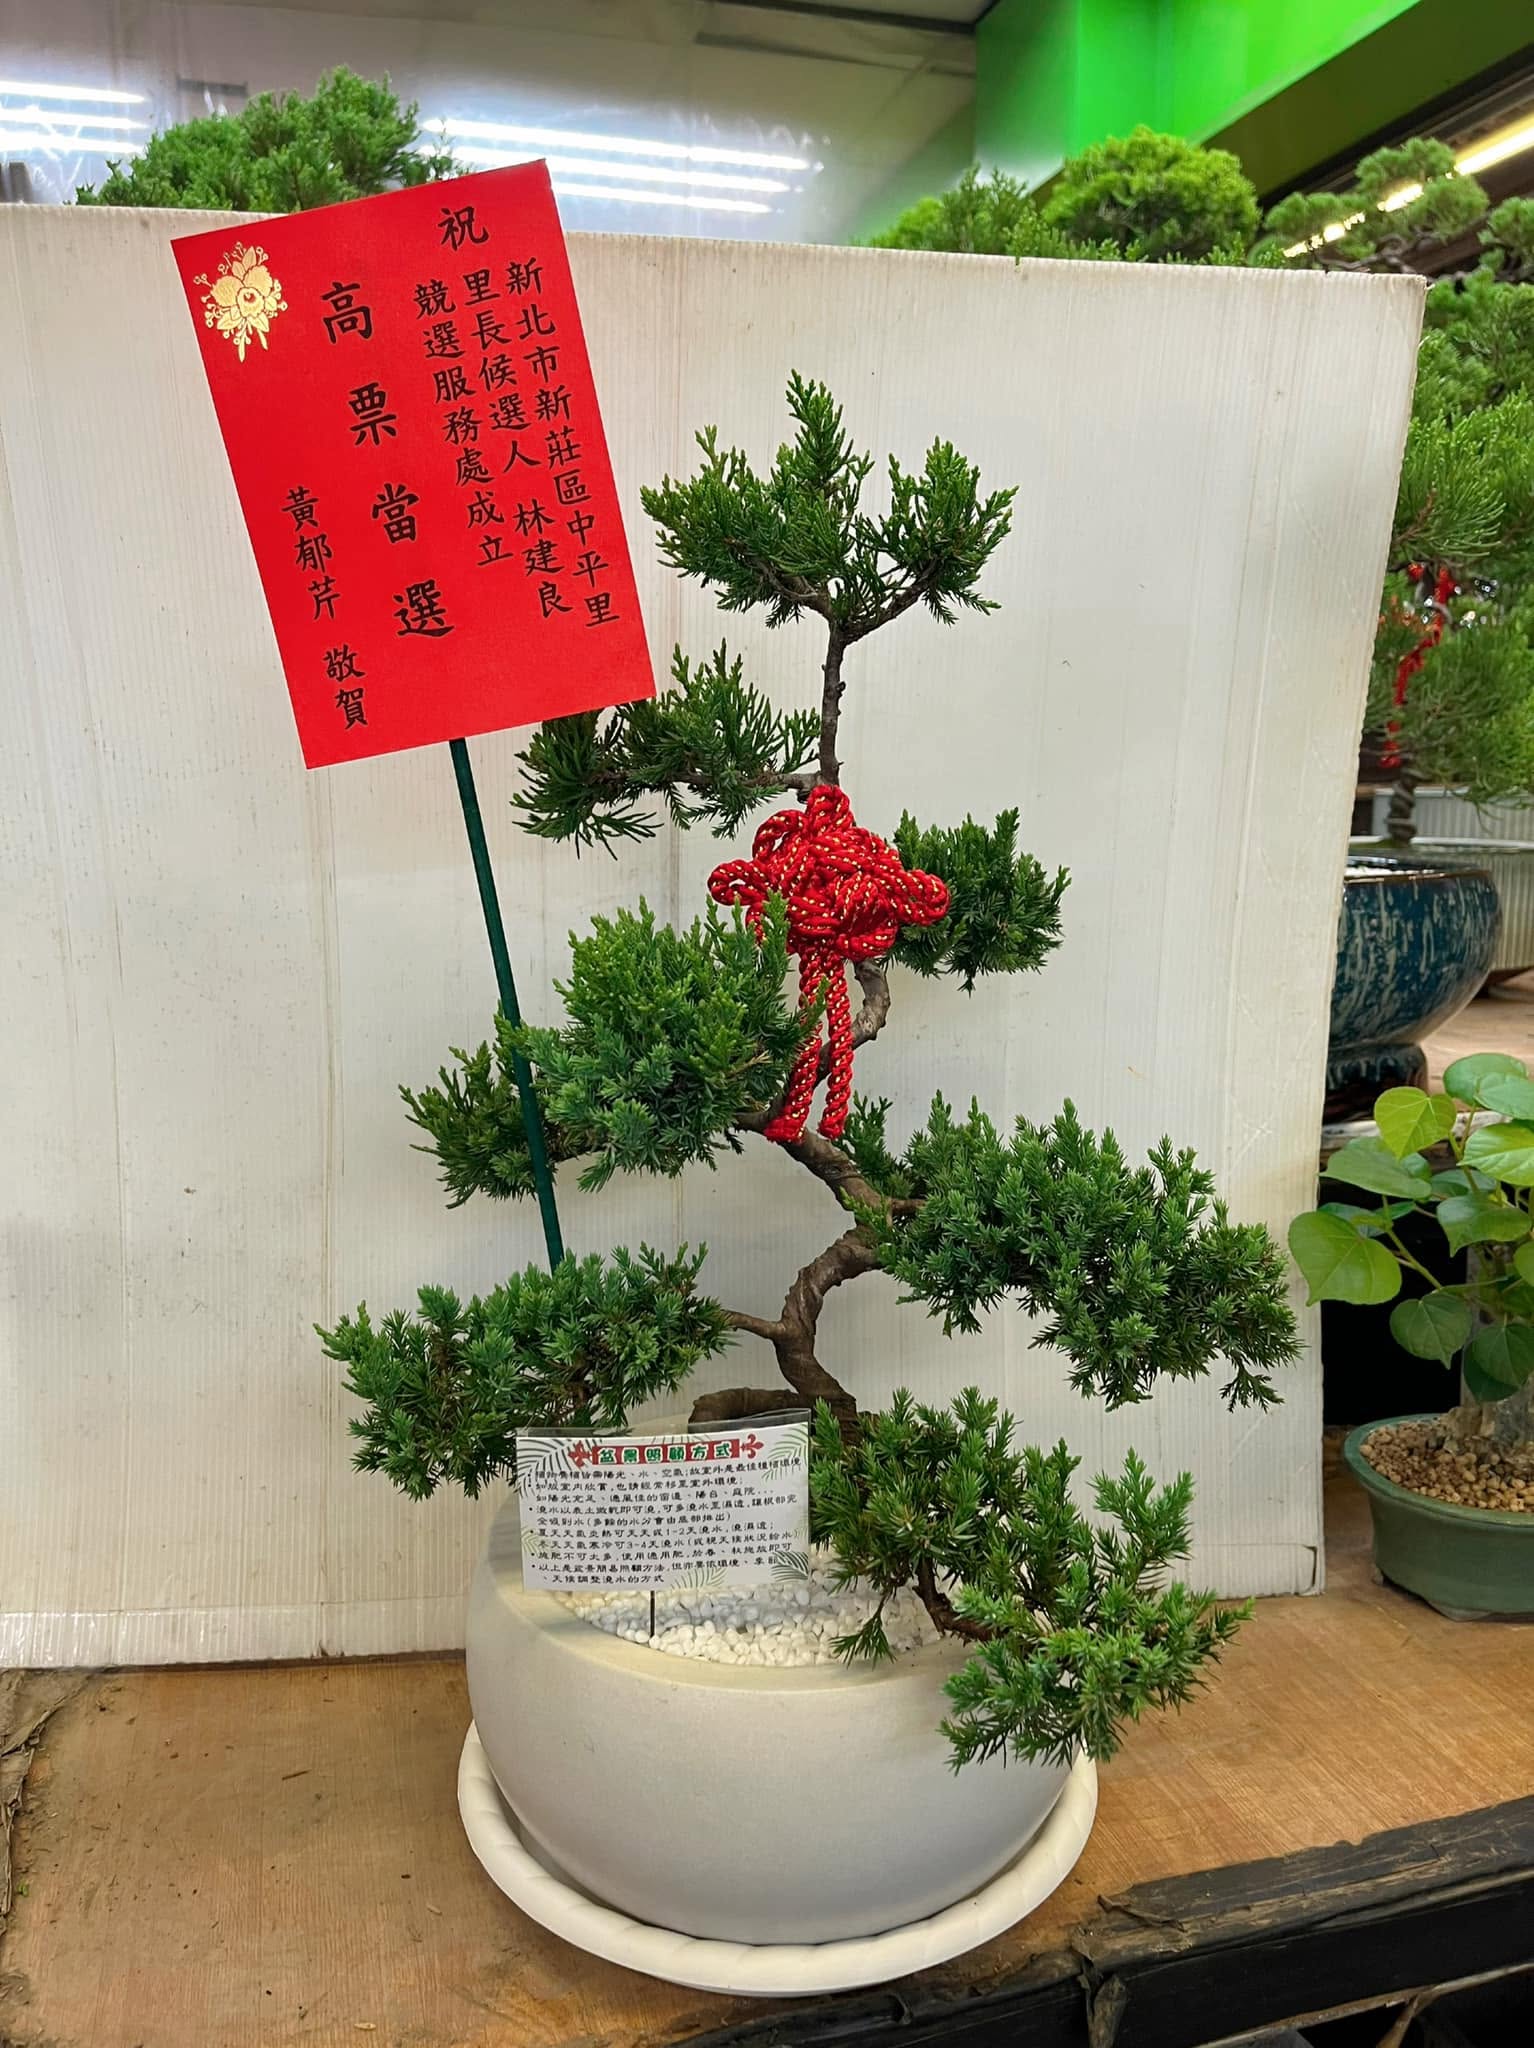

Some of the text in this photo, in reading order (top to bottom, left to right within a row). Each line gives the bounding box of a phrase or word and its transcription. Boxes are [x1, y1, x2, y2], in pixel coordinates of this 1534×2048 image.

[439, 207, 488, 251] 祝
[322, 282, 454, 636] 高票當選
[415, 280, 513, 566] 競選服務處成立
[464, 269, 572, 618] 里長候選人 林建良
[508, 257, 619, 627] 新北市新莊區中平里
[283, 487, 367, 729] 黃郁芹 敬賀
[599, 1443, 731, 1463] 盆景照顧方式
